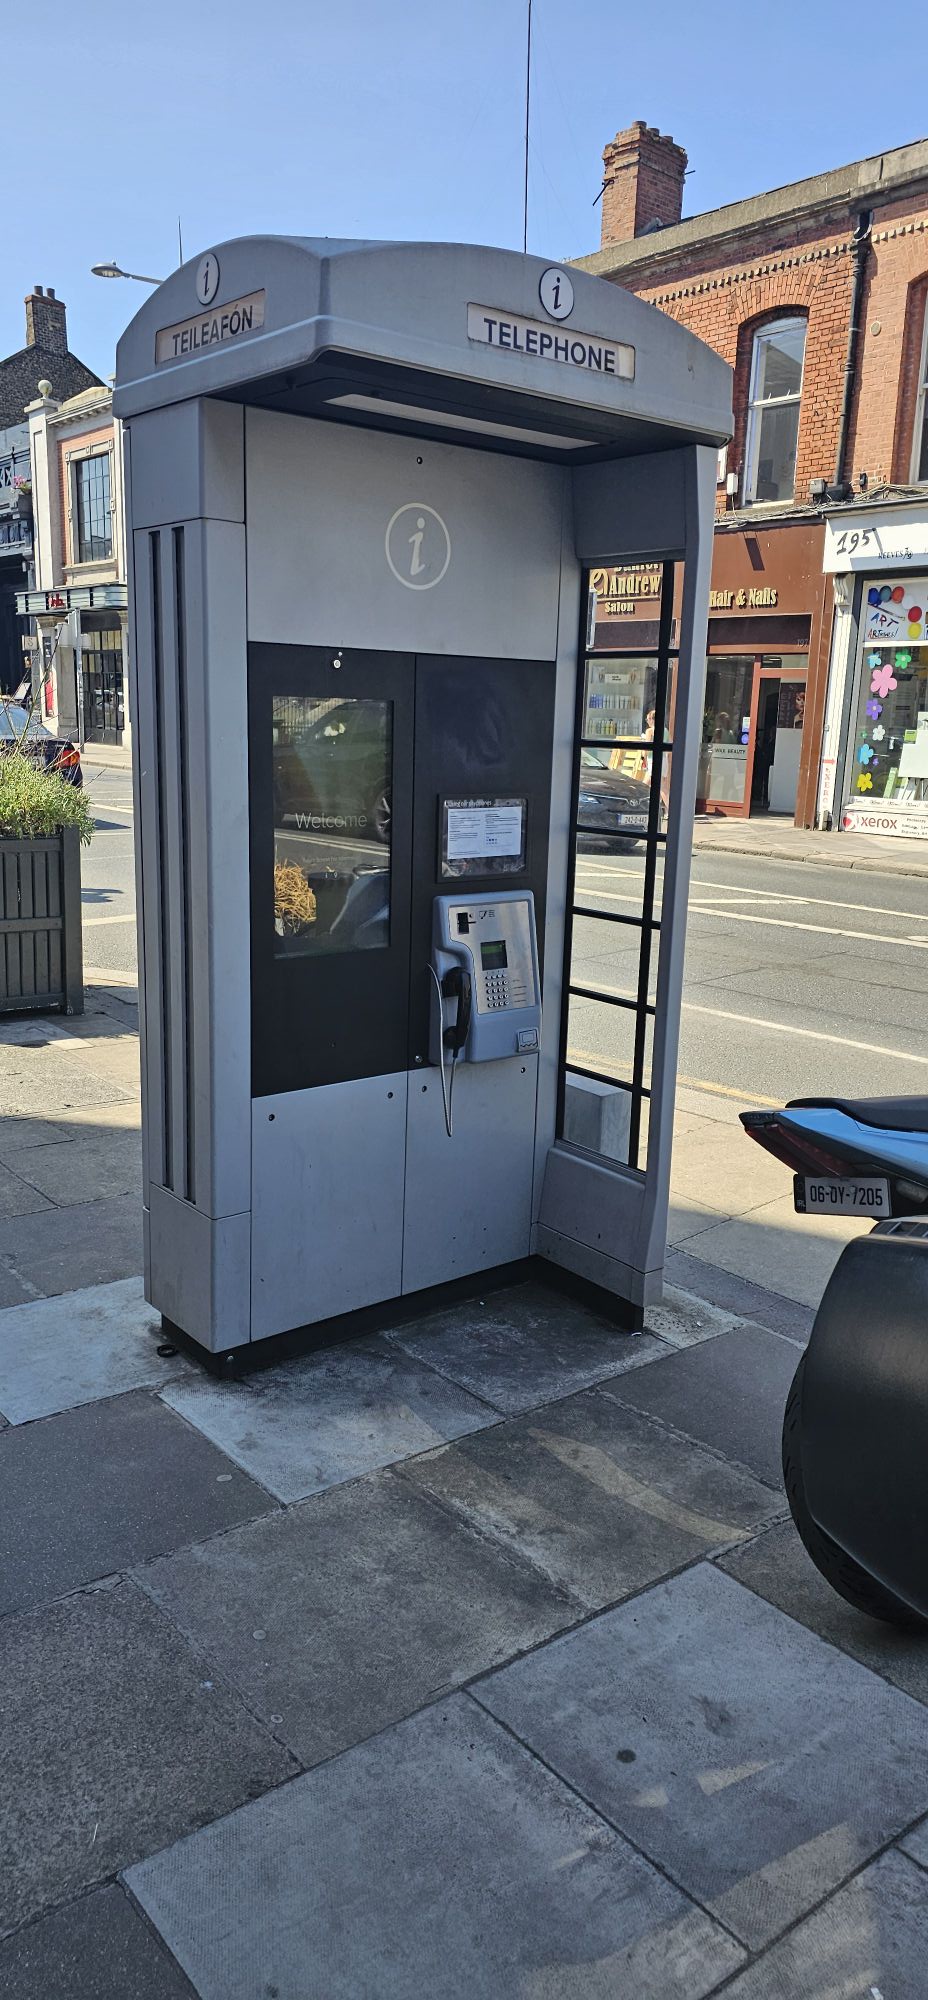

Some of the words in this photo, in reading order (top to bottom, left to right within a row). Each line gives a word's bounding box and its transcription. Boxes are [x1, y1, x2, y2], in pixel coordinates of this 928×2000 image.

[172, 304, 253, 356] TEILEAFÓN
[483, 317, 615, 373] TELEPHONE
[837, 529, 872, 555] 195
[609, 573, 661, 595] Andrew
[605, 601, 634, 612] Salon
[709, 590, 734, 607] Hair
[735, 589, 746, 606] &
[749, 587, 777, 605] Nails
[295, 812, 368, 829] Welcome
[861, 816, 898, 830] xerox
[809, 1185, 883, 1206] 06-OY-7205
